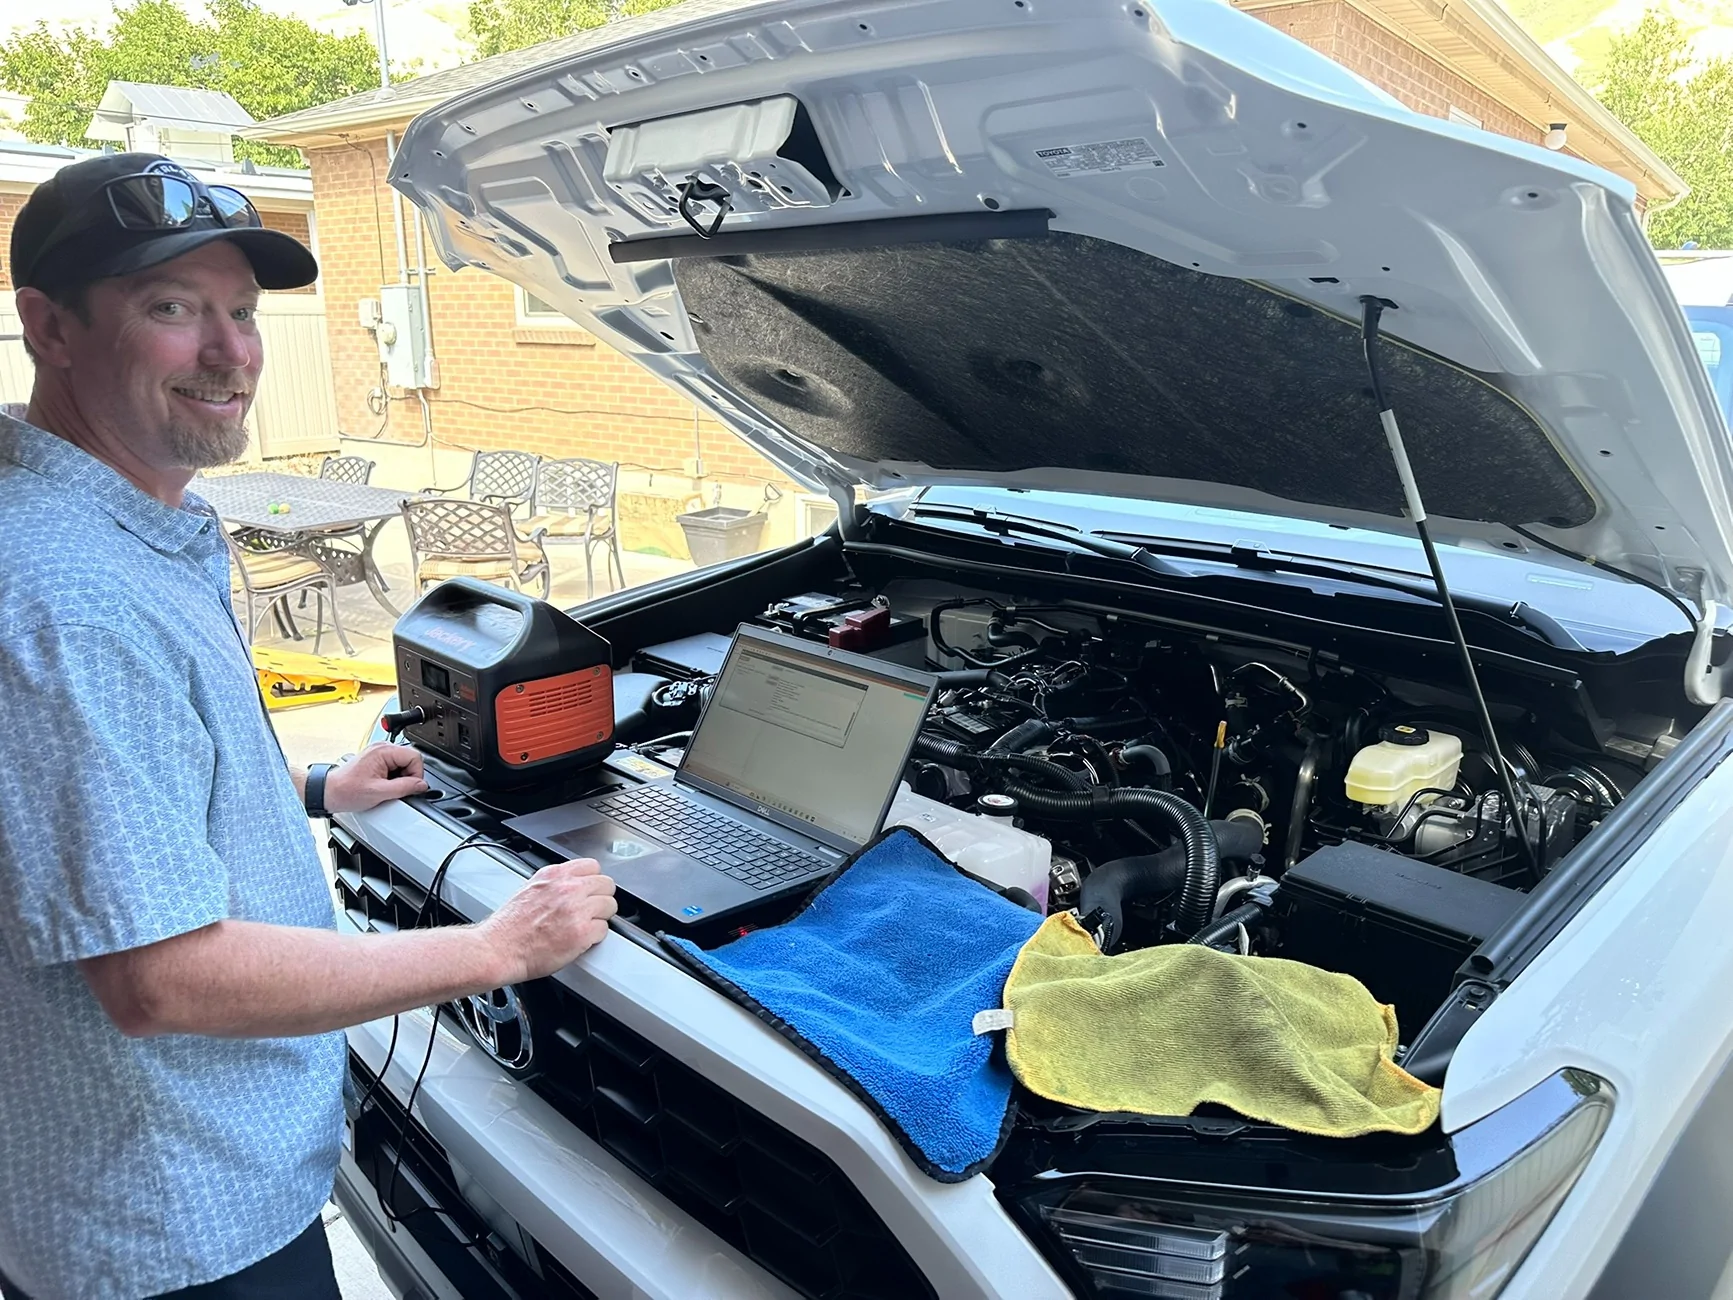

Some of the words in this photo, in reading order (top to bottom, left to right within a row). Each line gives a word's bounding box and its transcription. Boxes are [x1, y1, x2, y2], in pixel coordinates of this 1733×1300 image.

[1038, 148, 1070, 157] TOYOTA
[425, 626, 477, 651] Jackery
[757, 805, 770, 815] DELL
